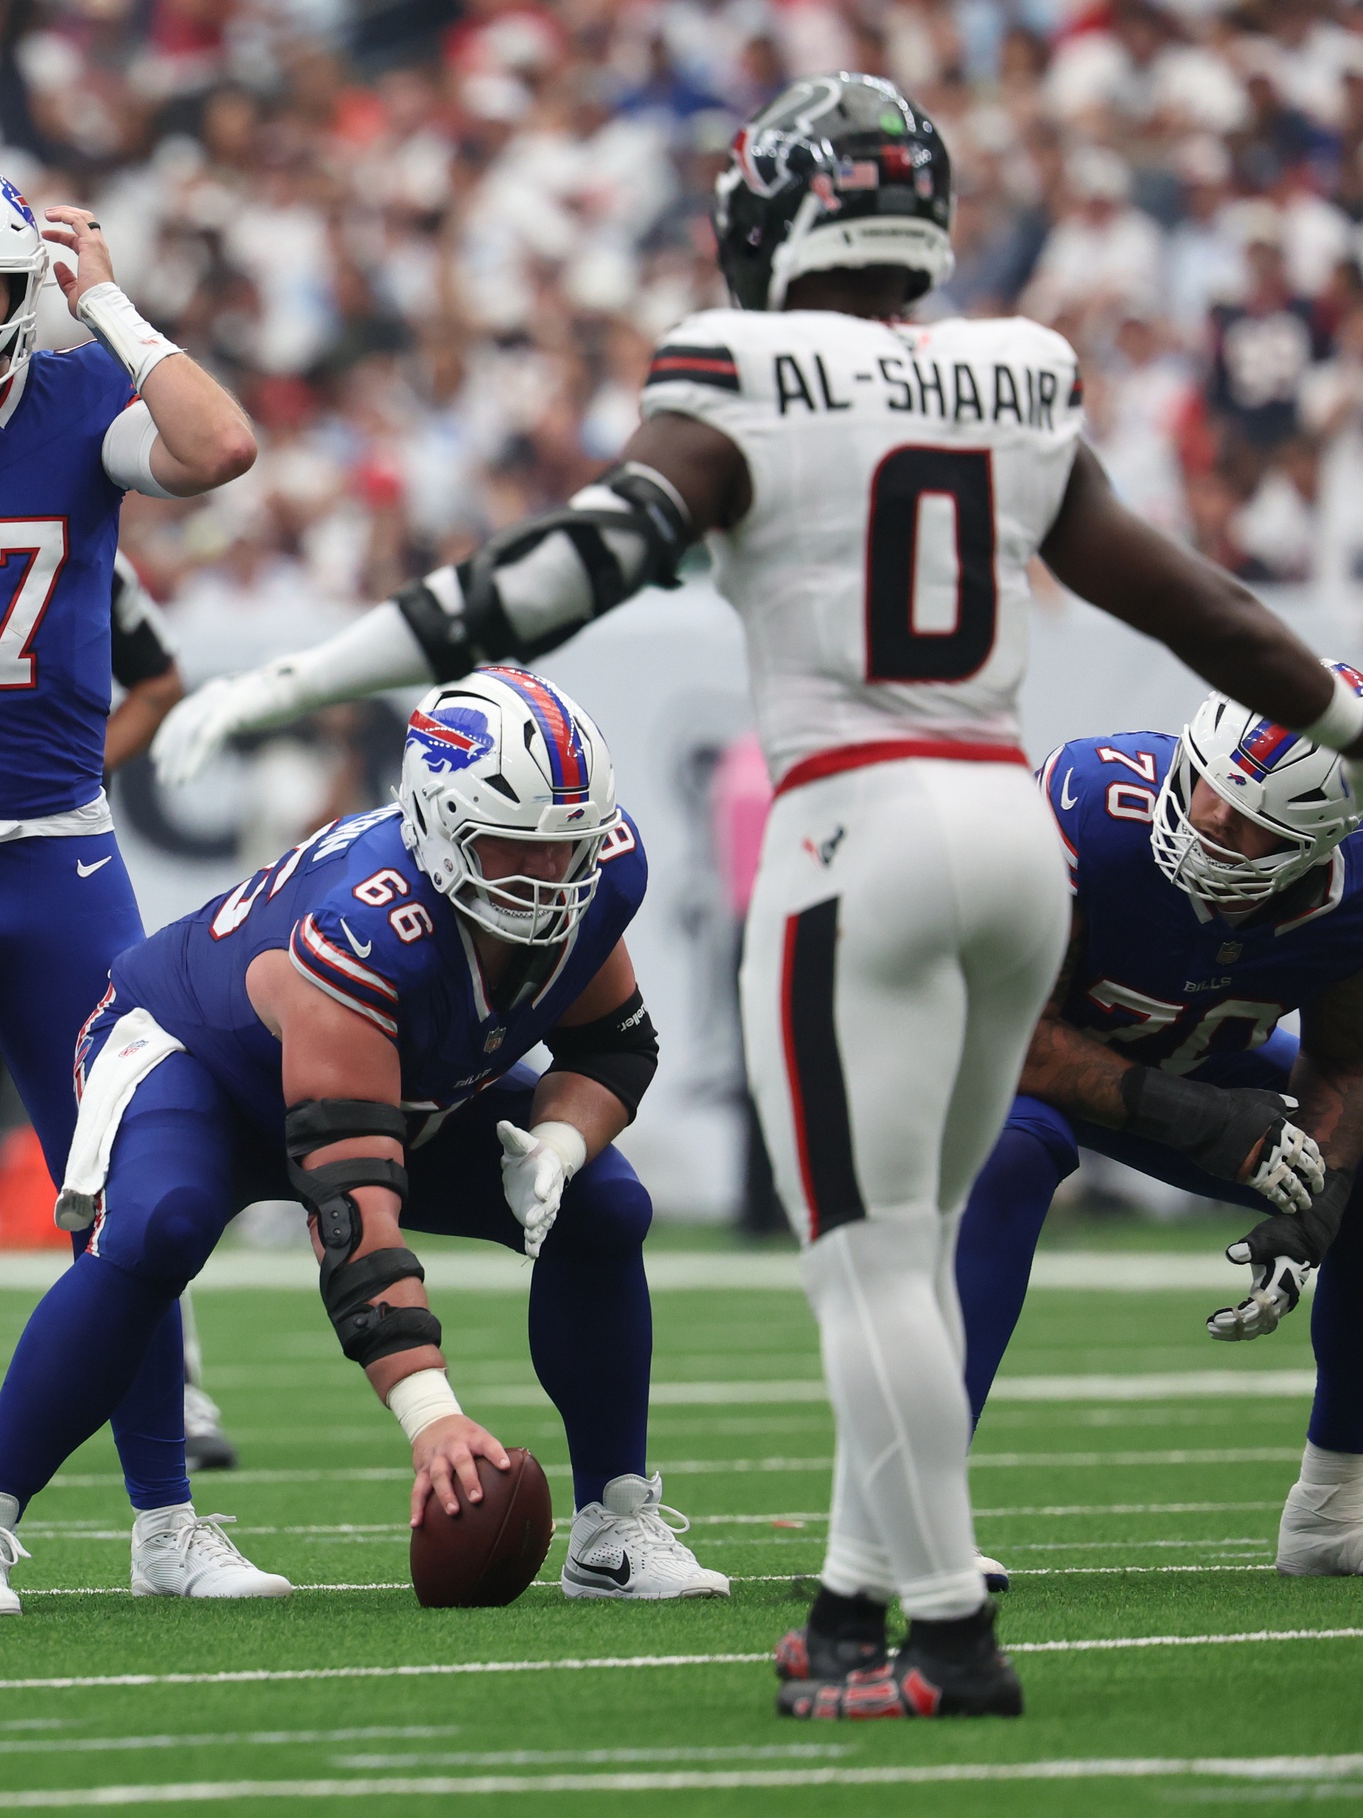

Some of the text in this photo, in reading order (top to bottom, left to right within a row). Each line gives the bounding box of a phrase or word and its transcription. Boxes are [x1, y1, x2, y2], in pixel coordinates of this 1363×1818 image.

[775, 352, 1058, 431] AL-SHAAIR
[865, 445, 998, 682] 0
[1095, 745, 1158, 825] 70
[352, 867, 434, 944] 66
[620, 1004, 646, 1032] ueller
[1184, 976, 1233, 993] BILLS
[1085, 977, 1287, 1077] 70
